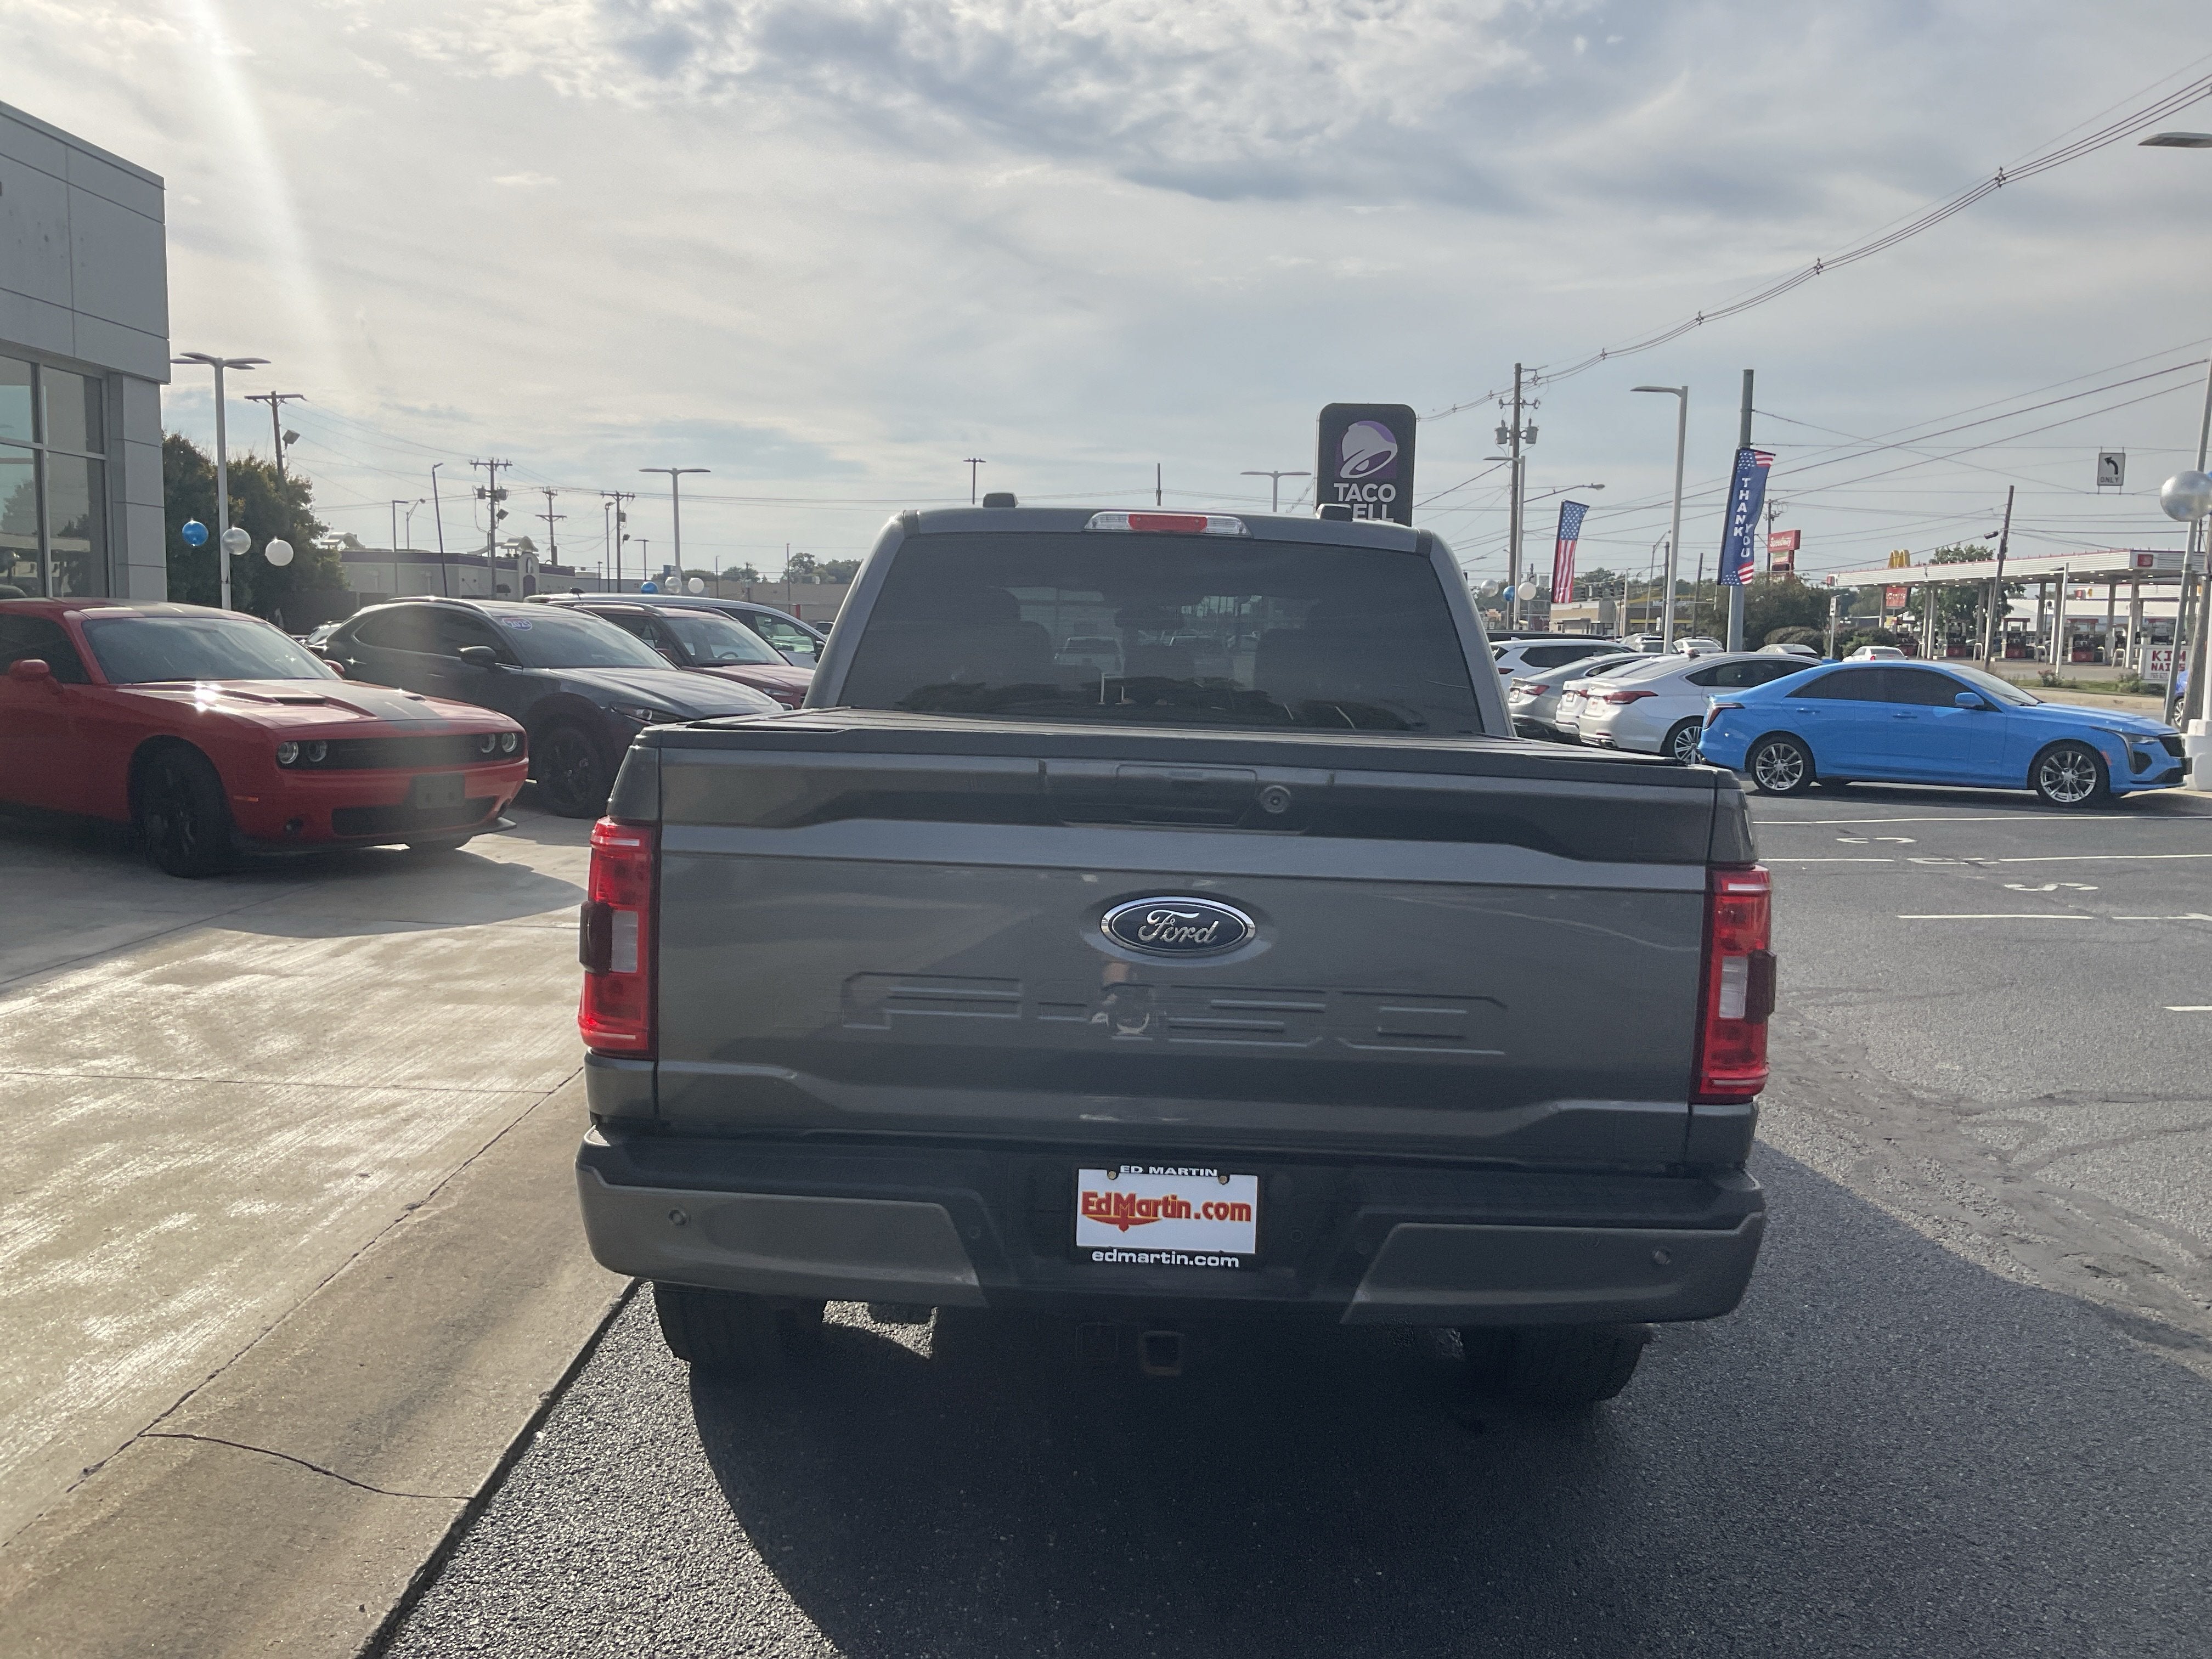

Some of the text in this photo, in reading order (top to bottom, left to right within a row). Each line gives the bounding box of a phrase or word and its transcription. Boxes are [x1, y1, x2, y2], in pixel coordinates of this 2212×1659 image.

[1334, 483, 1396, 503] TACO
[1353, 504, 1394, 521] ELL
[1734, 477, 1751, 537] THANK
[1740, 523, 1753, 558] YOU
[2151, 663, 2185, 672] NAIS
[1137, 909, 1219, 944] Ford
[1120, 1165, 1218, 1177] ED MARTIN
[1082, 1191, 1251, 1222] EdMartin.com
[1092, 1249, 1239, 1268] edmartin.com
